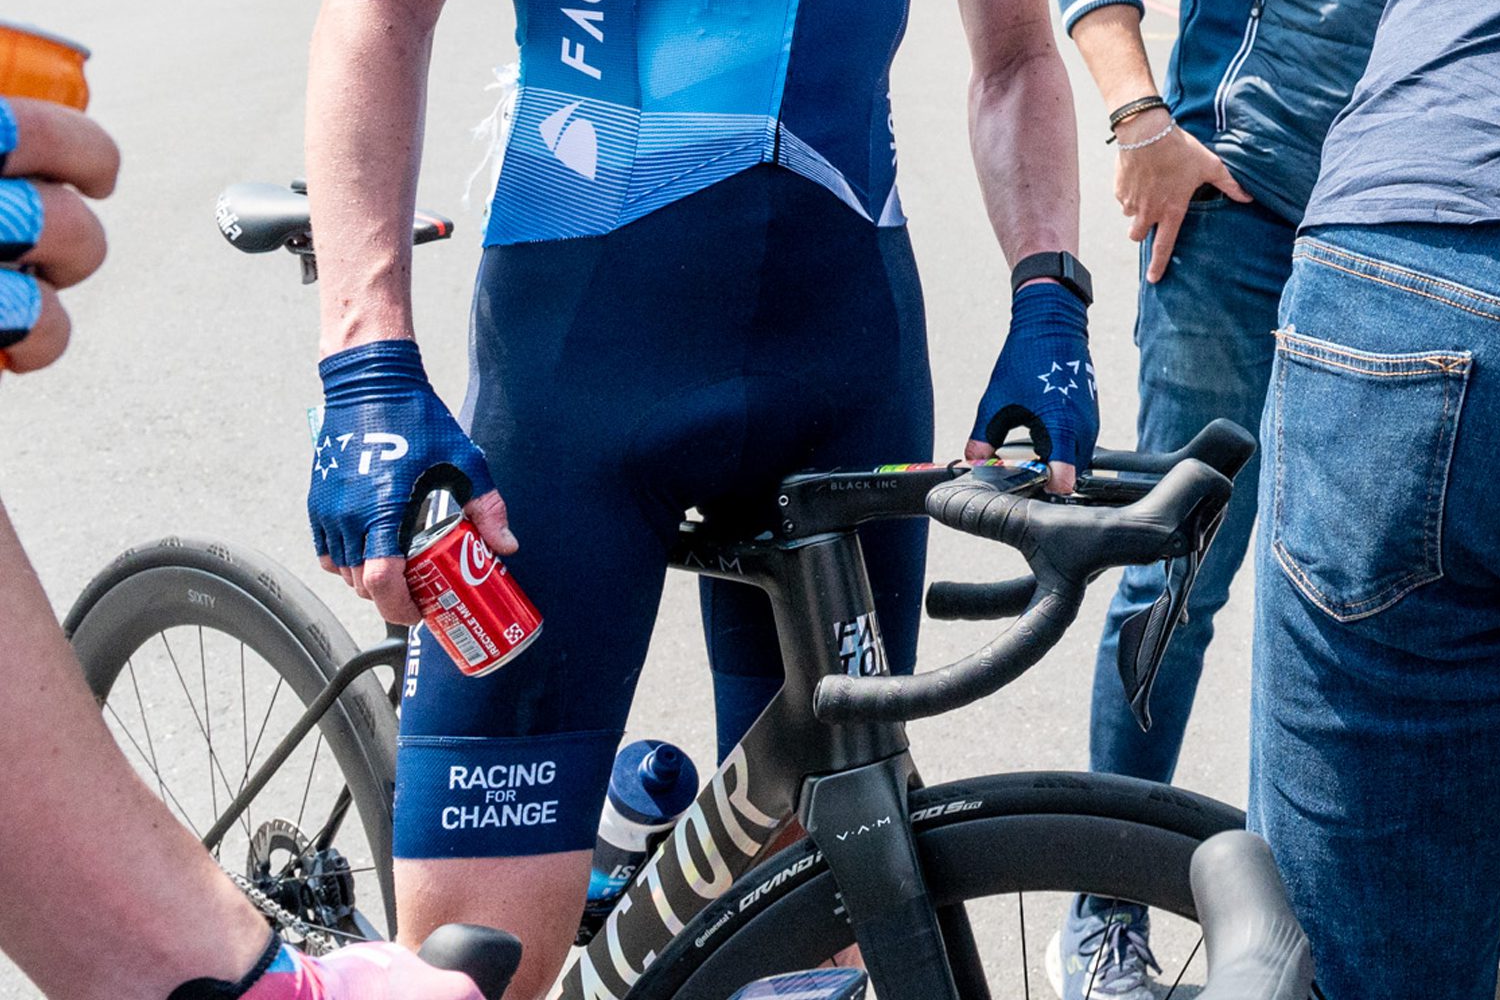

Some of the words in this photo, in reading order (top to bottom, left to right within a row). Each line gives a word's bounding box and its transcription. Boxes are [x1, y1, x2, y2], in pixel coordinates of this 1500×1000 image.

[830, 480, 870, 491] BLACK
[876, 480, 898, 489] INC
[449, 761, 557, 790] RACING
[485, 789, 517, 804] FOR
[441, 800, 559, 830] CHANGE
[738, 853, 815, 913] GRAND
